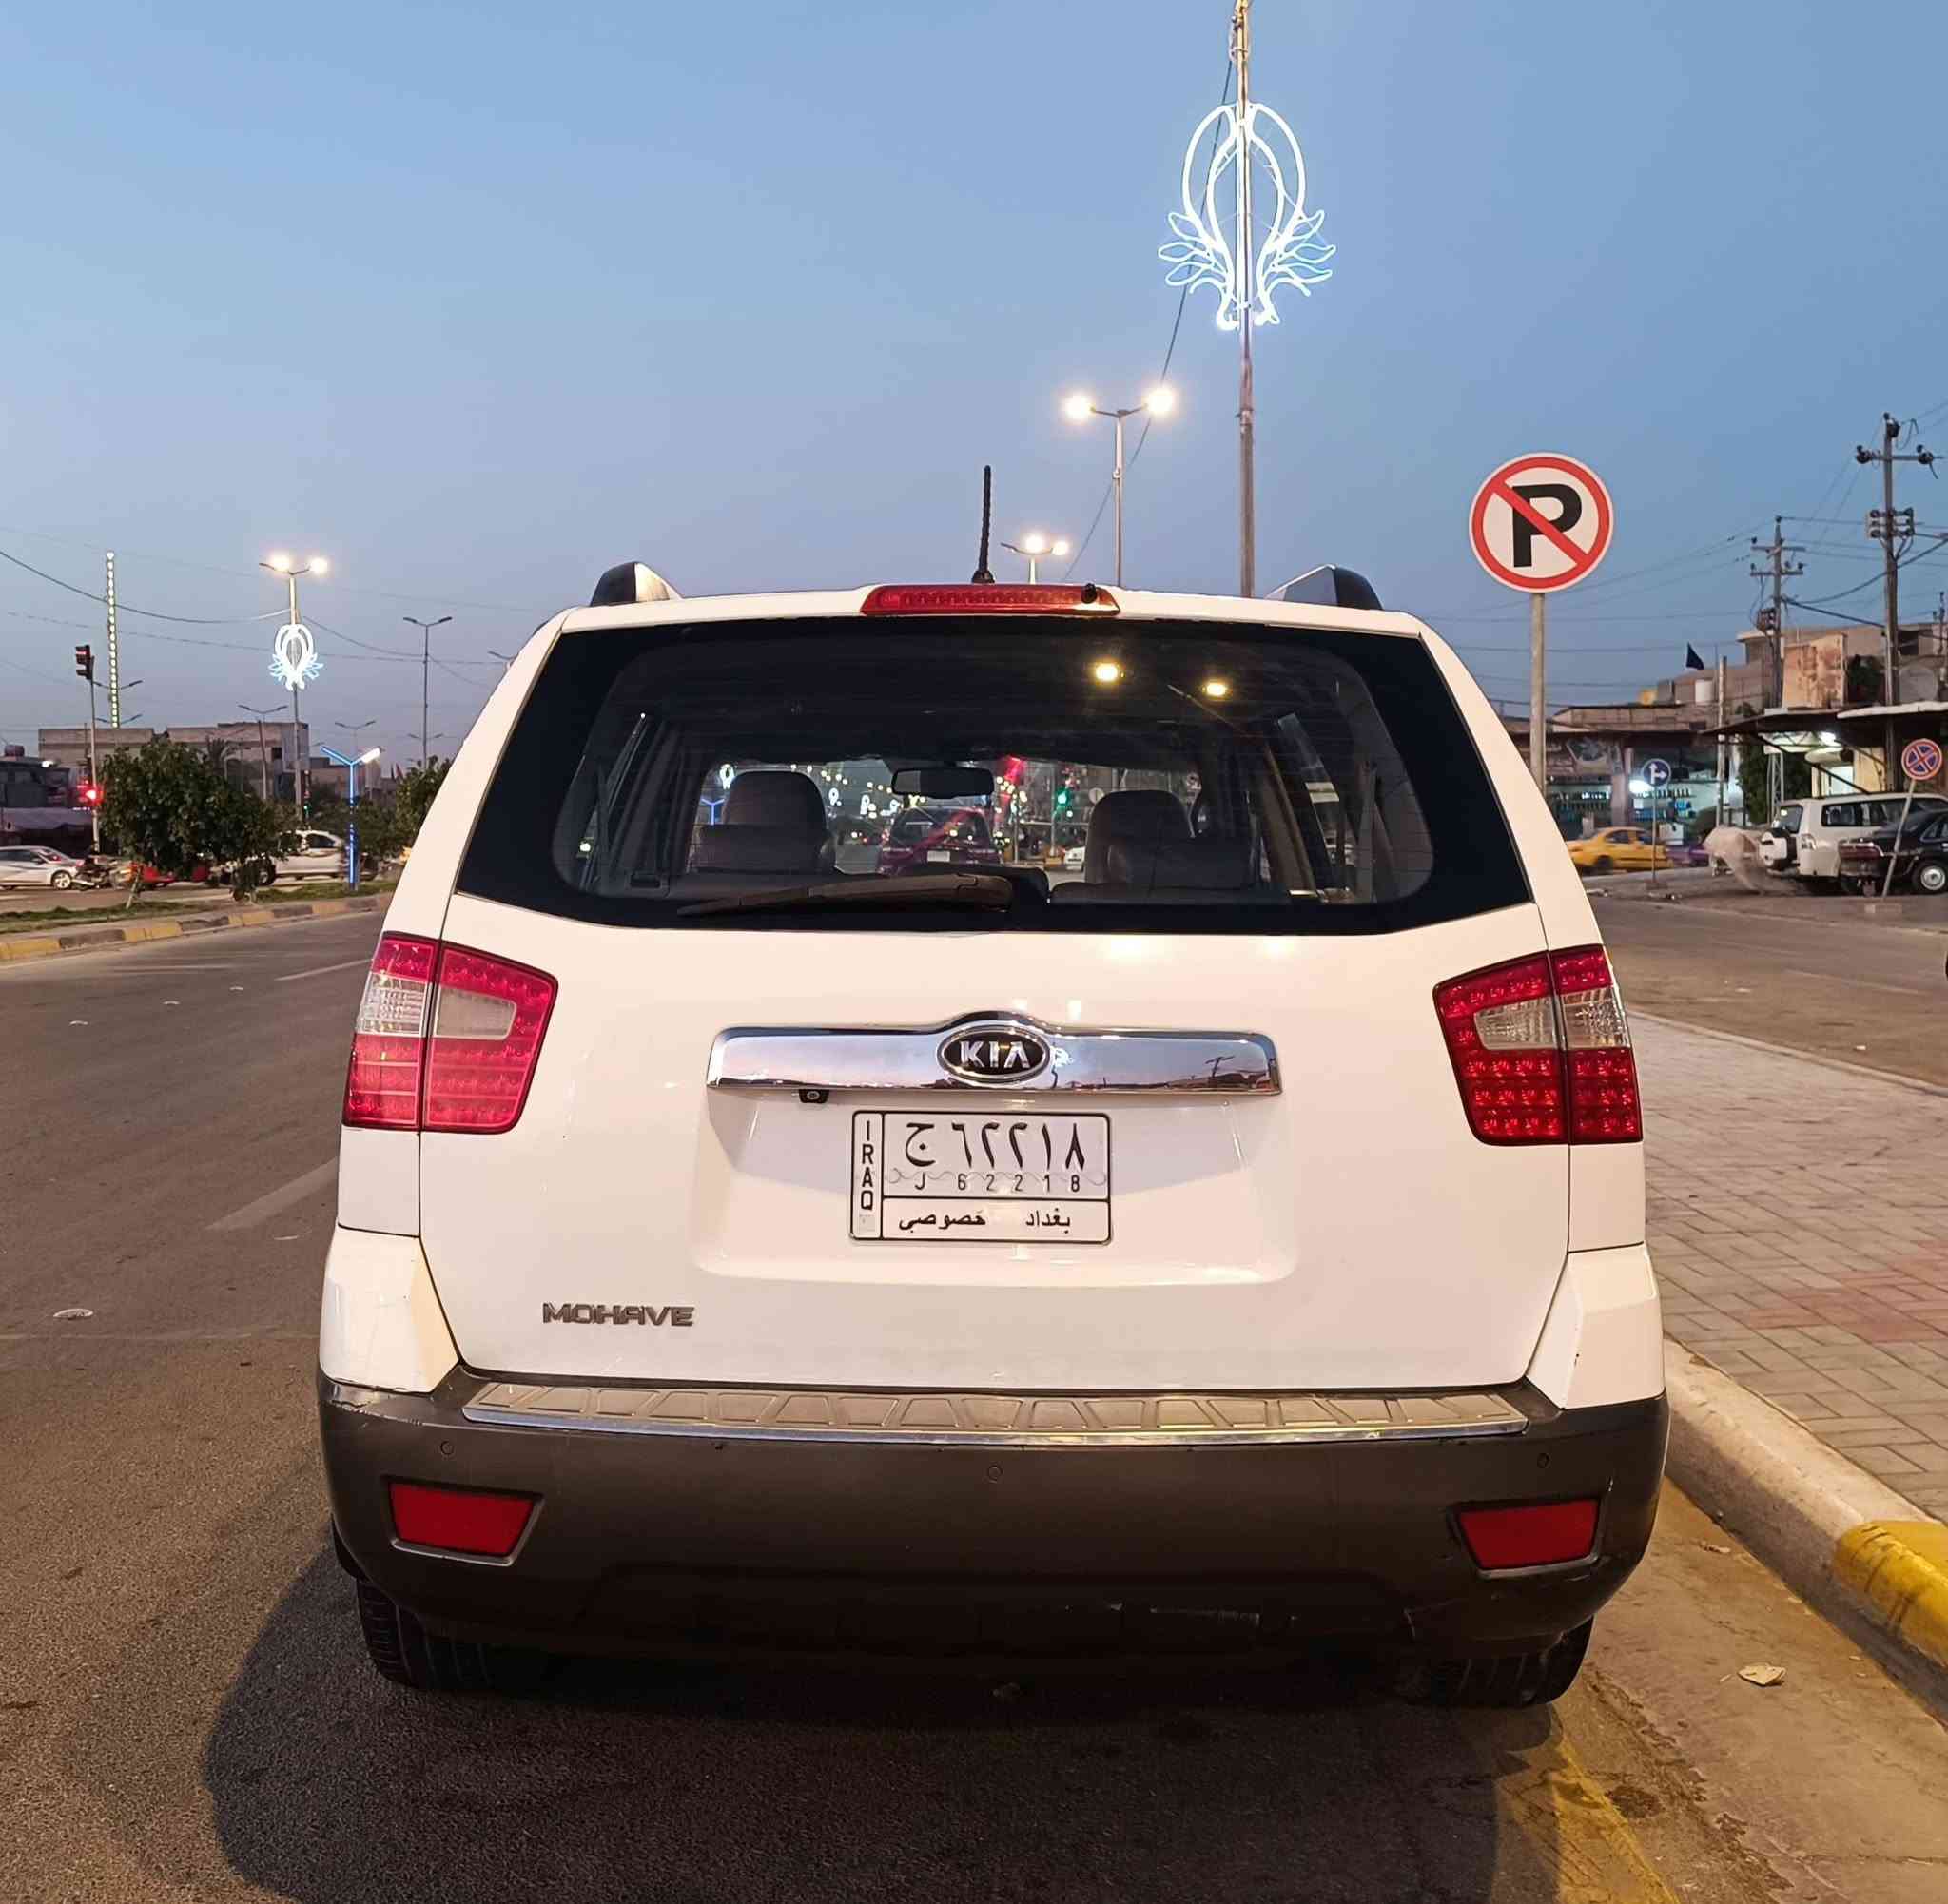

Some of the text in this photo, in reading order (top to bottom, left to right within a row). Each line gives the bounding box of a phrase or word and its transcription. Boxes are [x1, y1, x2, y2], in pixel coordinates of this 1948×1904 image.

[1512, 483, 1582, 568] P
[959, 1040, 1031, 1069] KIA
[860, 1120, 874, 1211] IRAQ
[1025, 1207, 1071, 1234] بغداد
[542, 1302, 695, 1327] MOHAVE
